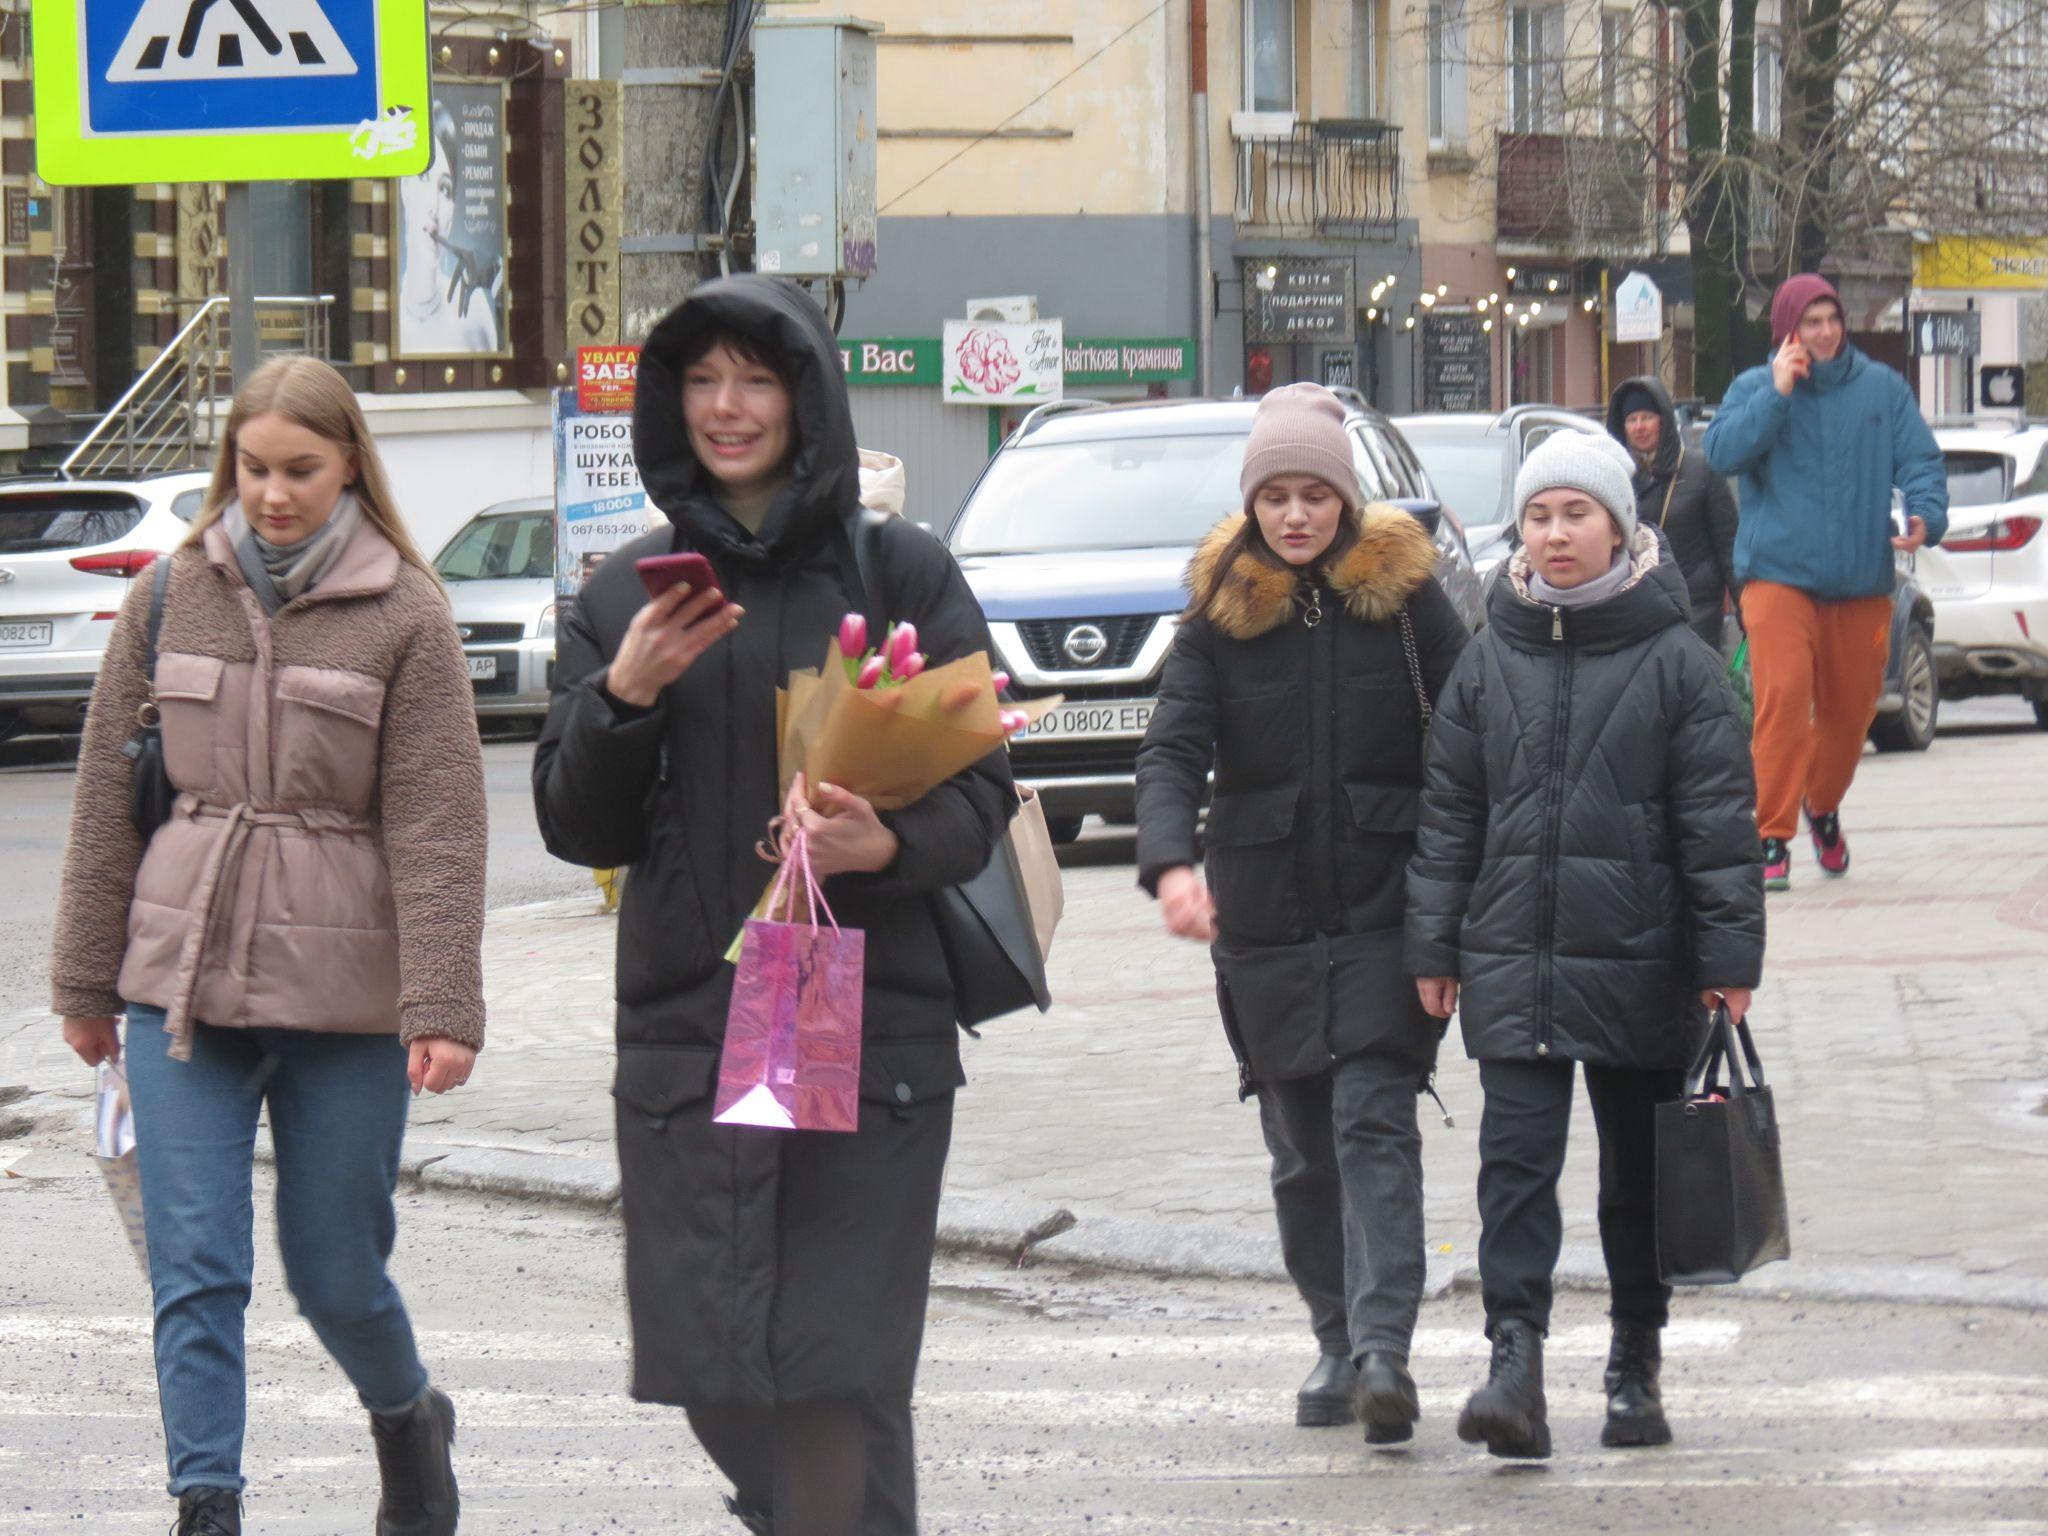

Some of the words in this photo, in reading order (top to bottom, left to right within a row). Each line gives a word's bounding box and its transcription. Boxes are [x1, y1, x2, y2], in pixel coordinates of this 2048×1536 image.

[464, 122, 495, 138] ПРОДАЖ
[464, 144, 488, 158] ОБМІН
[464, 166, 493, 180] РЕМОНТ
[577, 95, 609, 337] ЗОЛОТО
[1288, 274, 1330, 286] КВІТИ
[1272, 294, 1343, 308] ПОДАРУНКИ
[1287, 317, 1334, 330] ДЕКОР
[862, 343, 915, 372] Вас
[1064, 342, 1119, 372] квіткова
[1122, 345, 1183, 378] крамниця
[573, 424, 634, 440] РОБОТ
[577, 453, 634, 469] ШУКА
[571, 524, 649, 535] 067-653-20-0
[0, 626, 26, 641] 082
[28, 626, 49, 640] CT
[475, 659, 494, 672] AP
[1027, 713, 1058, 735] BO
[1063, 709, 1114, 734] 0802
[1120, 707, 1151, 730] EB
